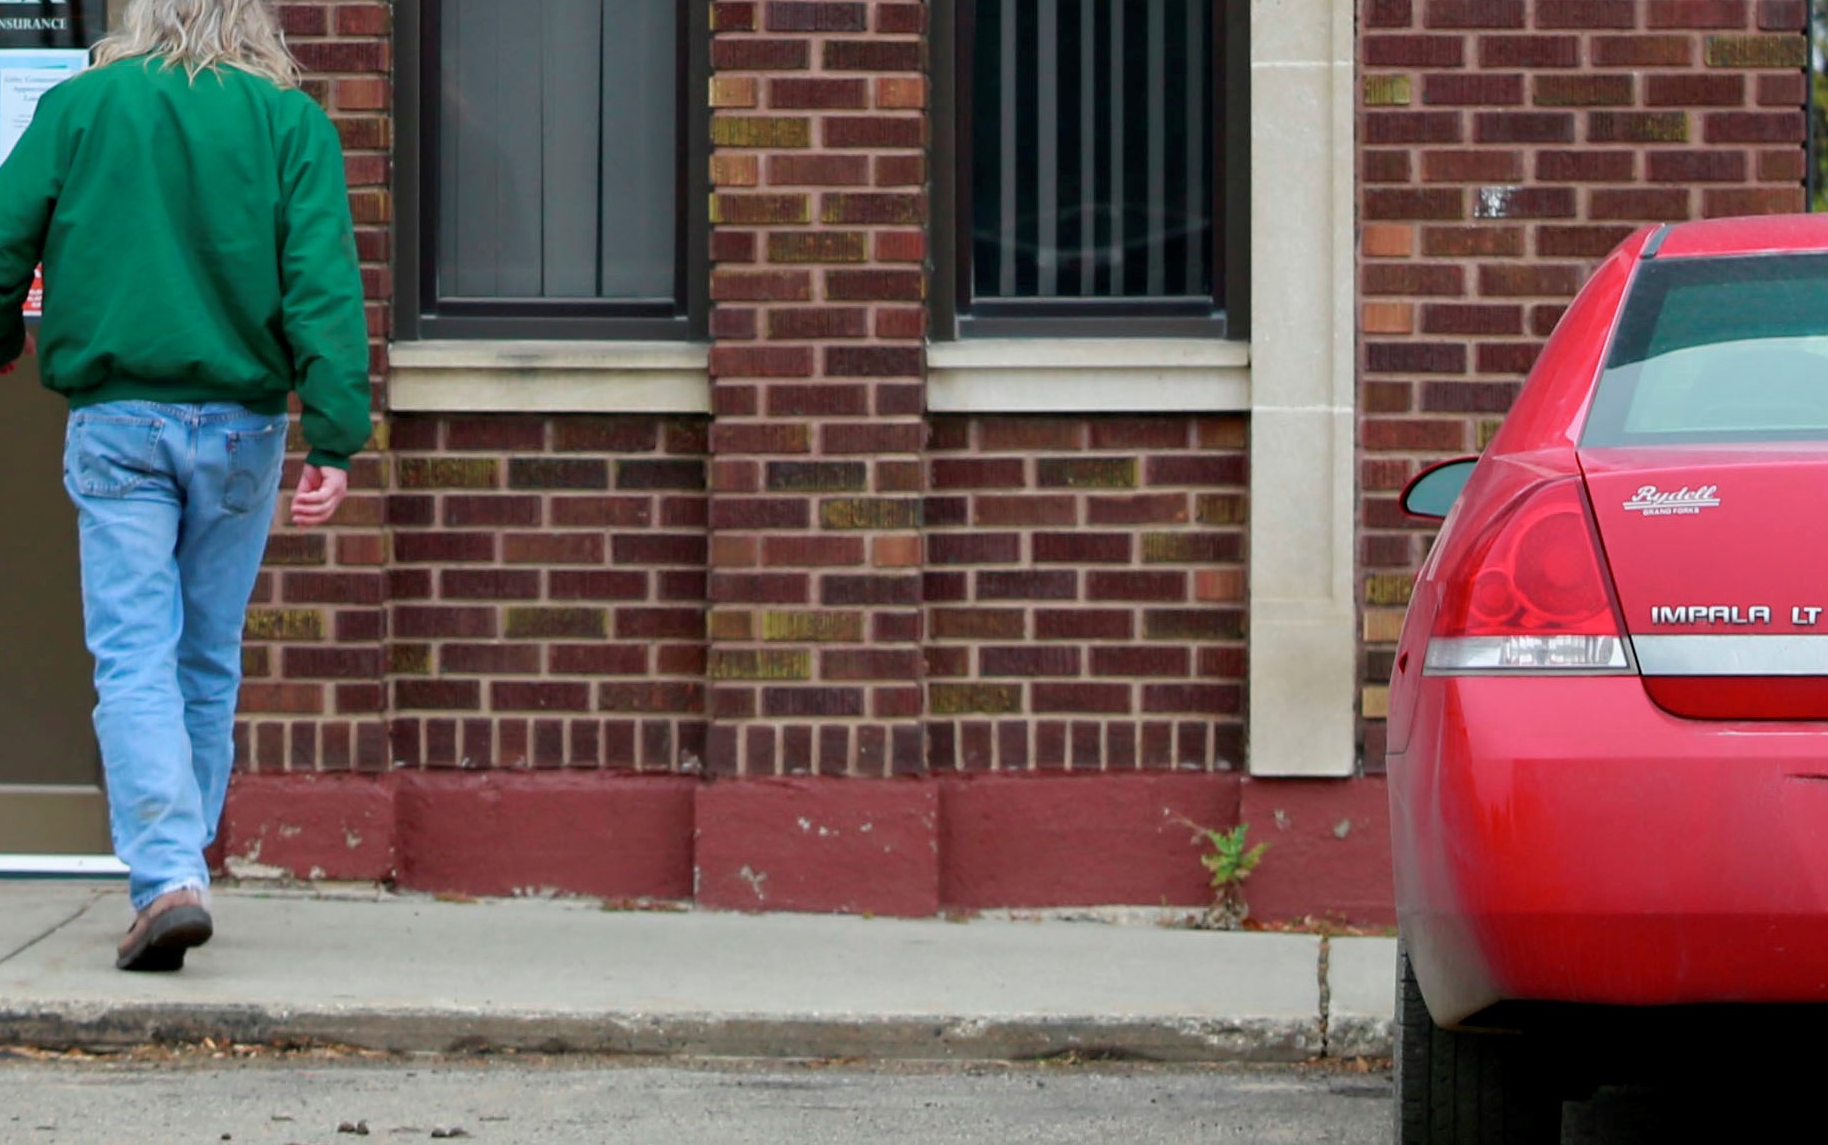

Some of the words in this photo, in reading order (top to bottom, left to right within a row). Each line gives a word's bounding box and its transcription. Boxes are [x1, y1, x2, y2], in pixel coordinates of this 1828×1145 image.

[1631, 485, 1718, 506] Rydell
[1643, 508, 1672, 516] GRAND
[1673, 506, 1700, 515] FORKS
[1651, 605, 1771, 625] IMPALA
[1791, 605, 1823, 625] LT
